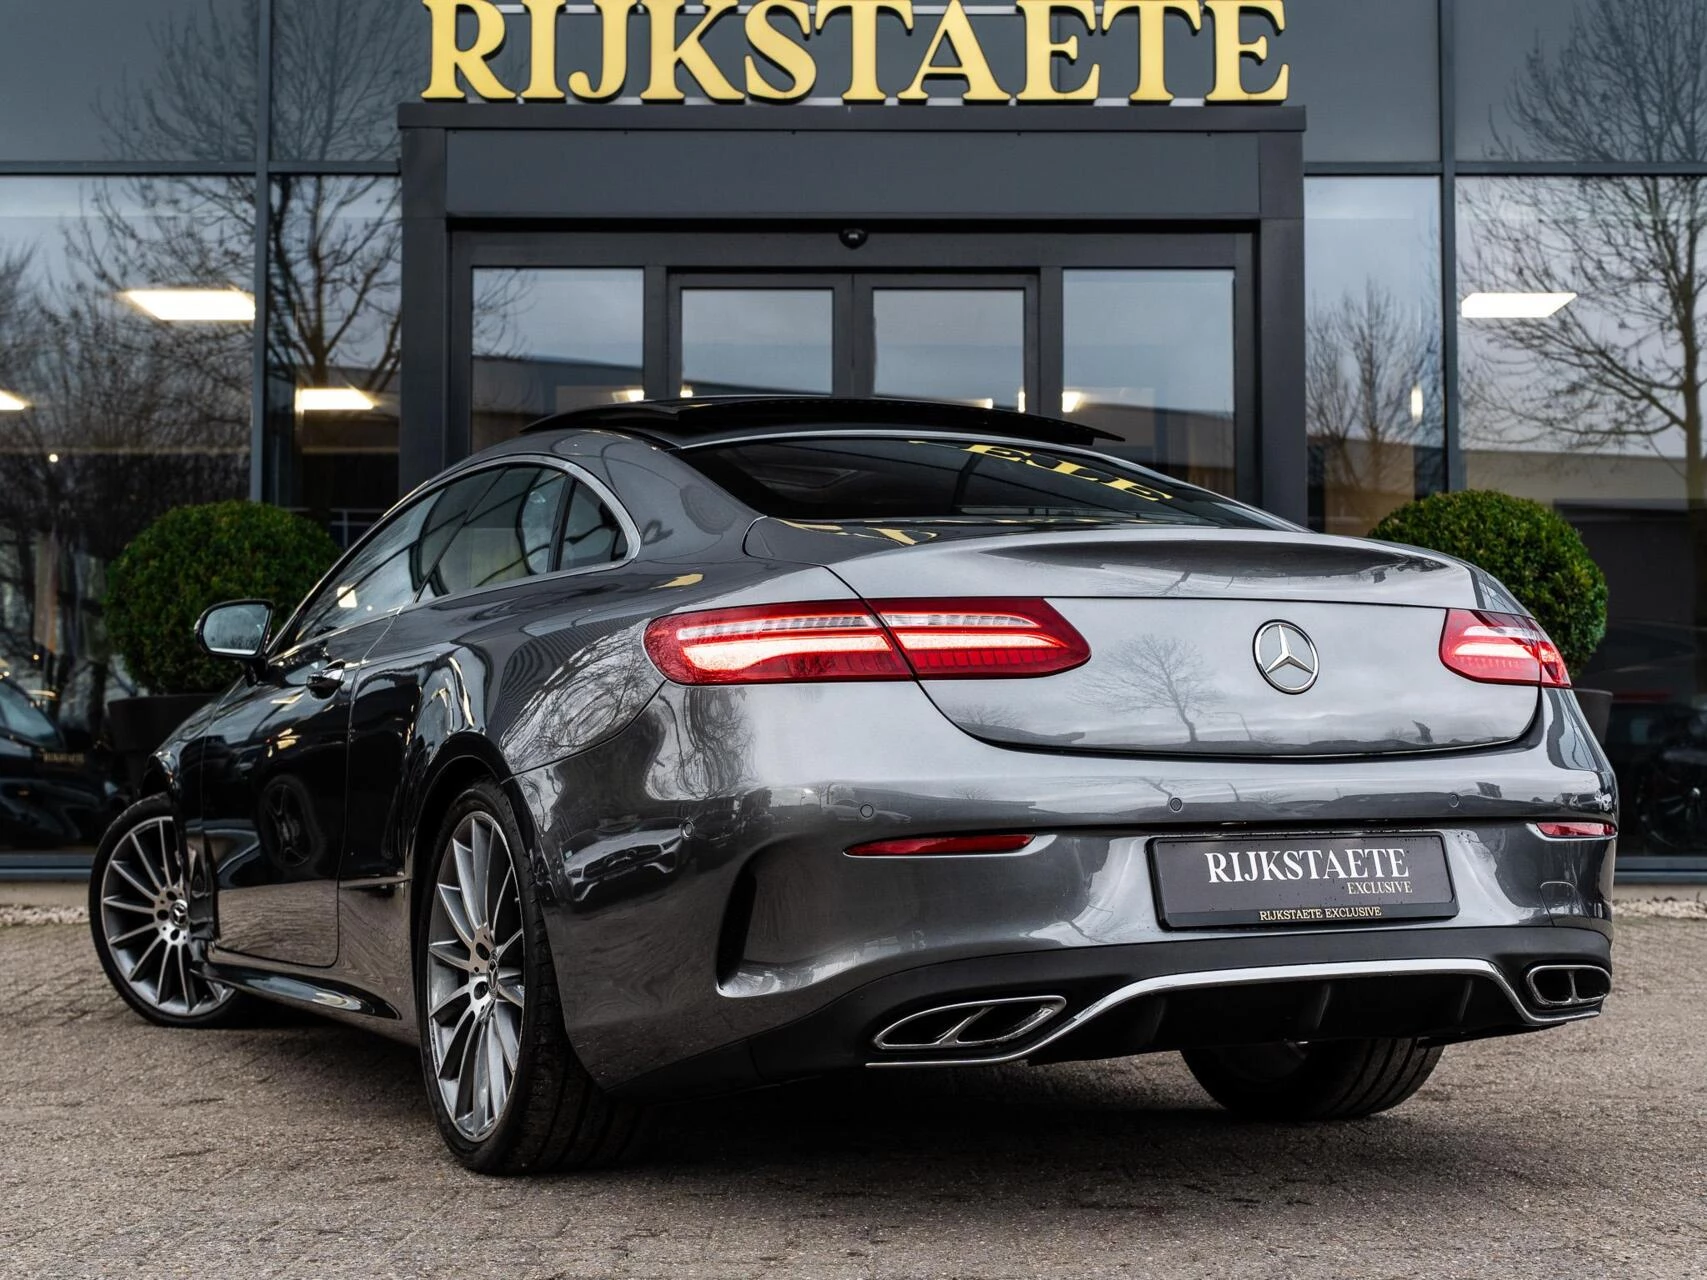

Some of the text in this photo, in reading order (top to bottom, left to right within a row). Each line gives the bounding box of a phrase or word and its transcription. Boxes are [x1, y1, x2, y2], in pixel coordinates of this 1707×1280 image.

[420, 0, 1290, 101] RIJKSTAETE
[1204, 848, 1410, 883] RIJKSTAETE
[1346, 881, 1413, 895] EXCLUSIVE
[1259, 906, 1382, 921] RIJKSTAETE EXCLUSIVE
